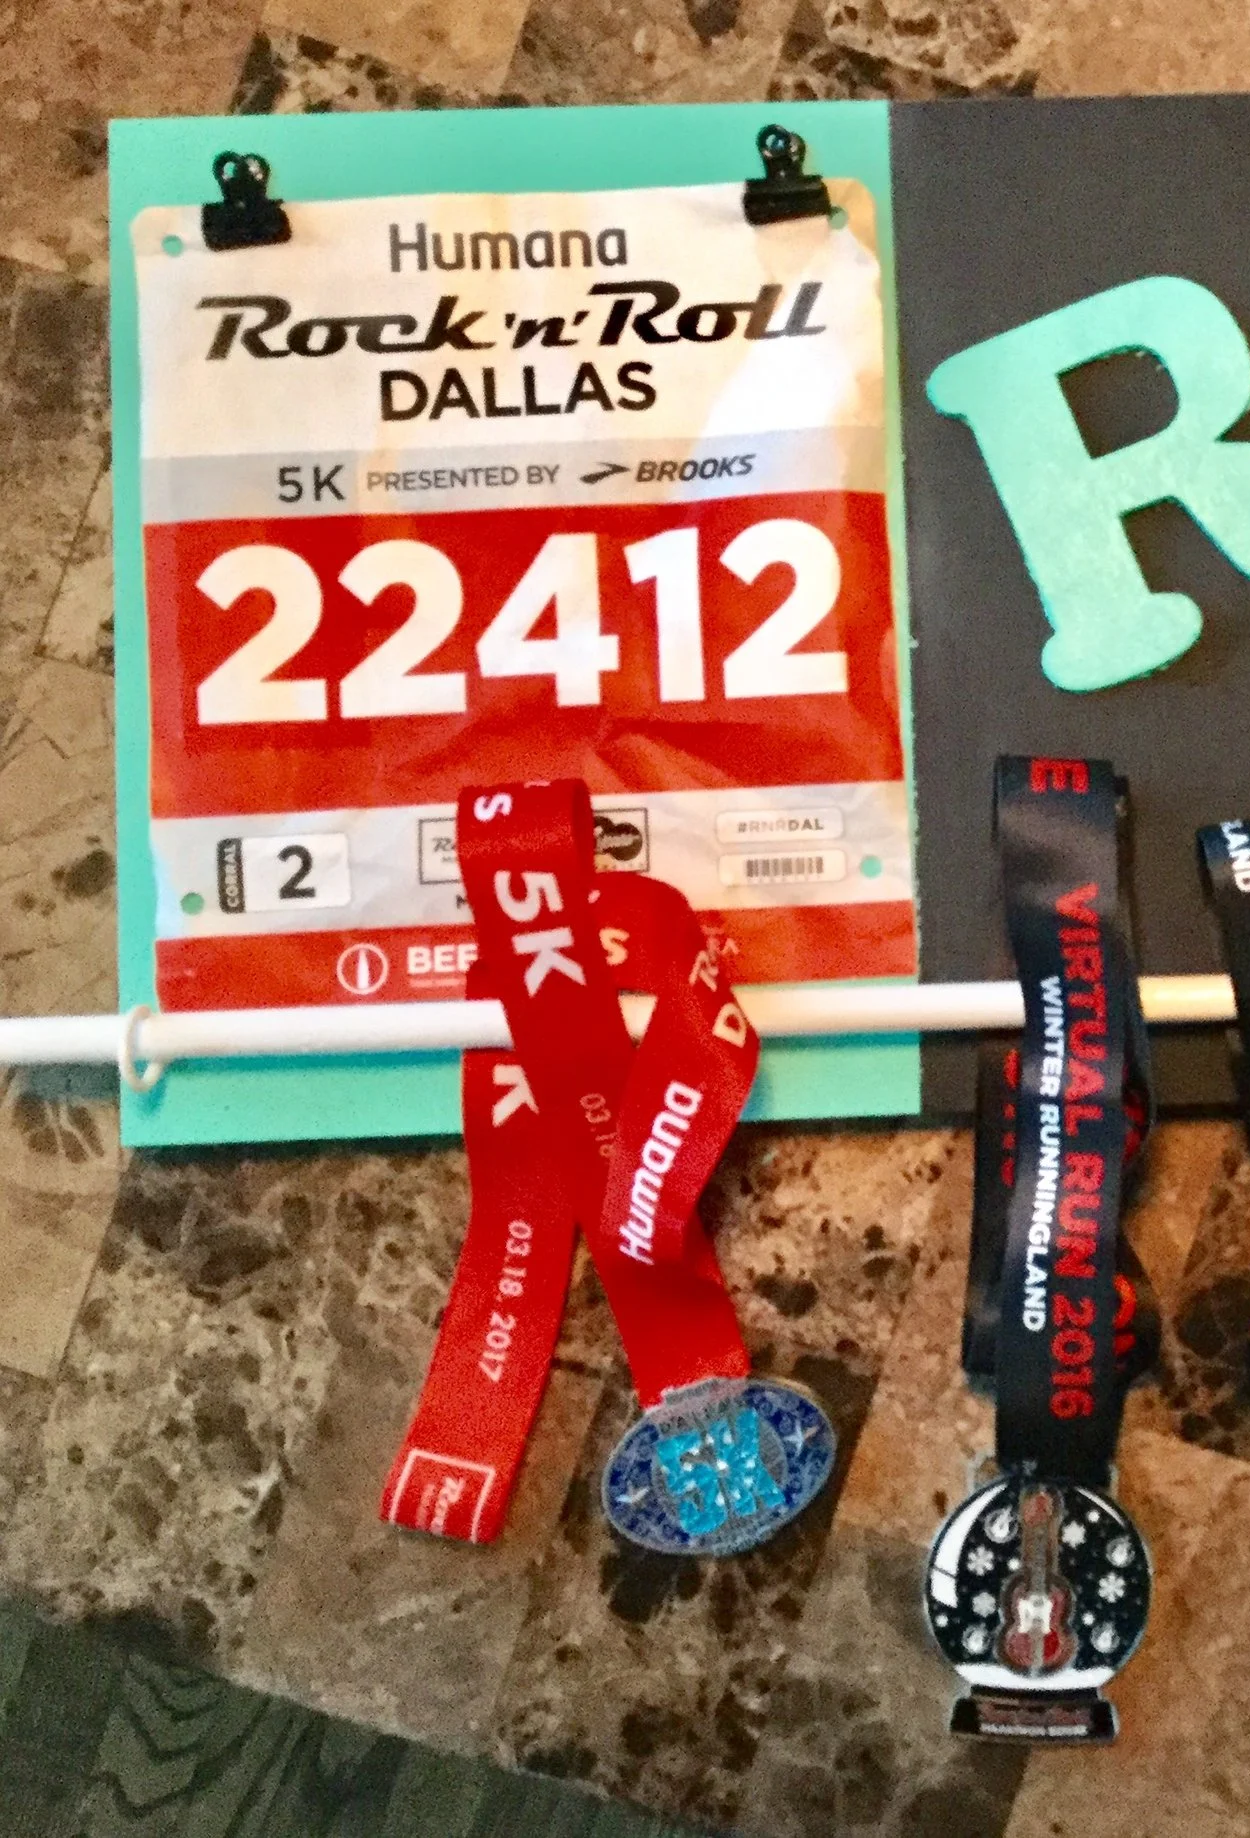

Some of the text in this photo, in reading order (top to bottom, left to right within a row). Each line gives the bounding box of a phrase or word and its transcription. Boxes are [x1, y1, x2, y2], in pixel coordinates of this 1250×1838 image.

[389, 223, 628, 274] Humana
[196, 294, 497, 361] Rock
[588, 280, 828, 345] Roll
[379, 362, 656, 422] DALLAS
[367, 467, 519, 491] PRESENTED
[526, 464, 560, 485] BY
[635, 454, 756, 483] BROOKS
[196, 518, 850, 725] 22412
[222, 843, 241, 908] CORRAL
[278, 844, 316, 900] 2
[494, 870, 586, 997] 5K
[618, 1080, 704, 1266] Humana
[1022, 975, 1065, 1333] WINTER RUNNINGLAND
[1048, 882, 1107, 1421] VIRTUAL RUN 2016
